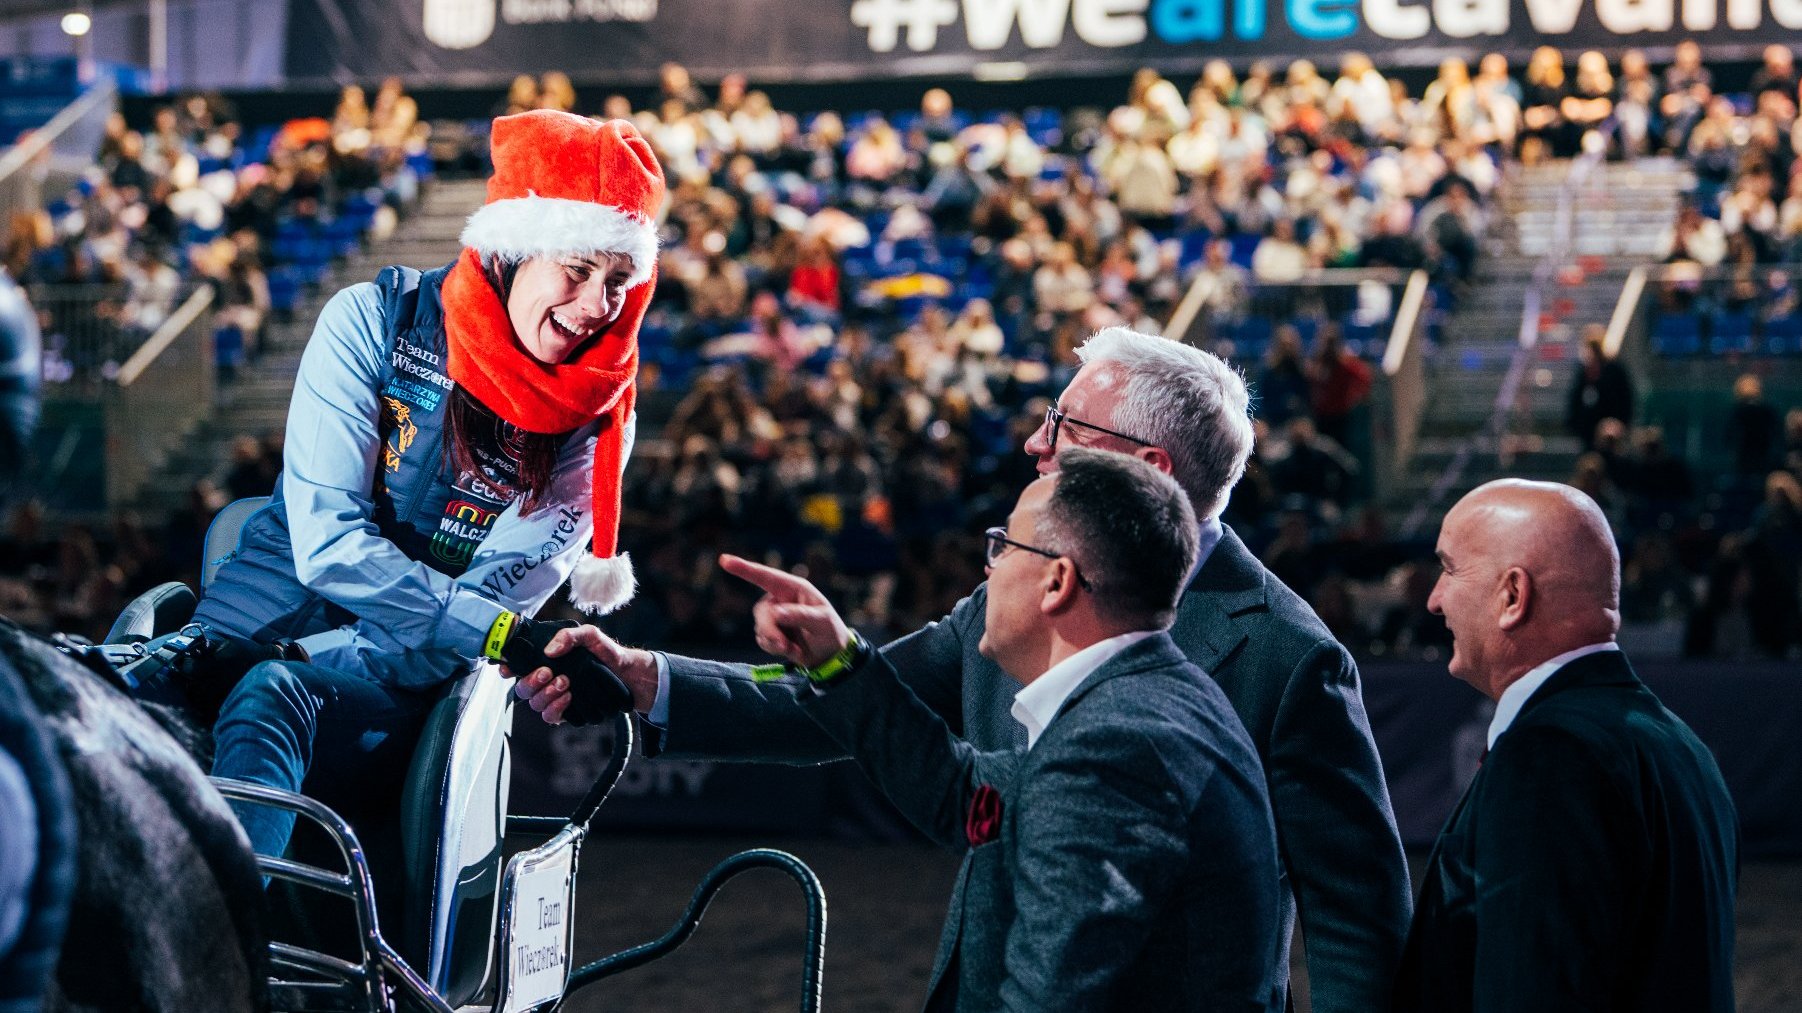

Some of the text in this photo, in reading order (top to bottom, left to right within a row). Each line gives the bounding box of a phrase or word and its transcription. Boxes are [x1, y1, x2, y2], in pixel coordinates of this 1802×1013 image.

[396, 335, 440, 366] Team
[387, 384, 437, 412] WIECZOREK
[391, 376, 441, 403] KATARZYNA
[439, 516, 489, 542] WALCZ
[538, 897, 561, 931] Team
[517, 935, 560, 978] Wieczorek
